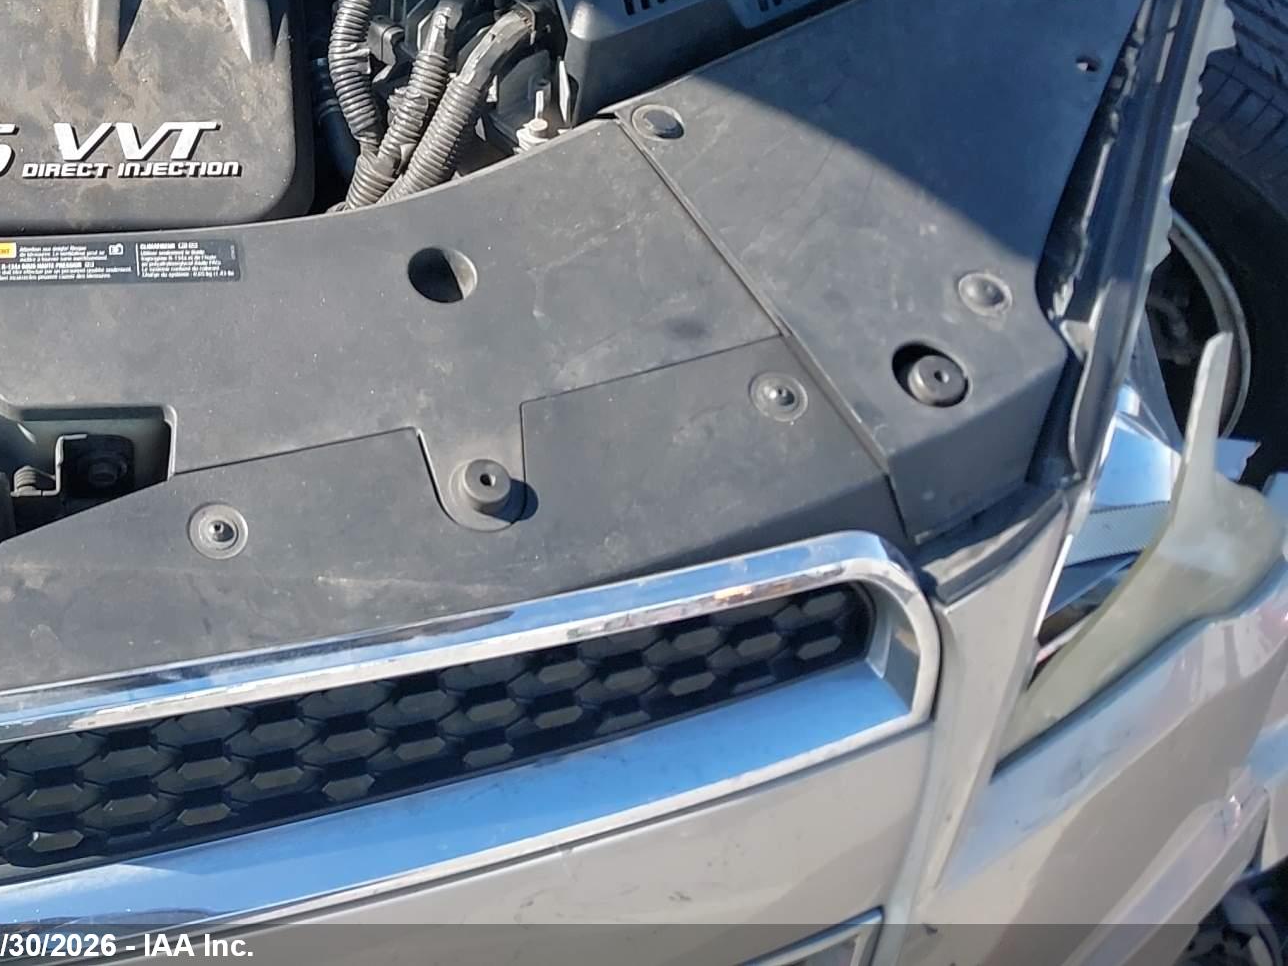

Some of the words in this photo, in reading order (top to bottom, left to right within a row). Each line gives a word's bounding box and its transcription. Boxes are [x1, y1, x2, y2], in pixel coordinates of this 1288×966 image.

[53, 121, 219, 161] VVT
[22, 163, 112, 178] DIRECT
[117, 161, 241, 177] INJECTION
